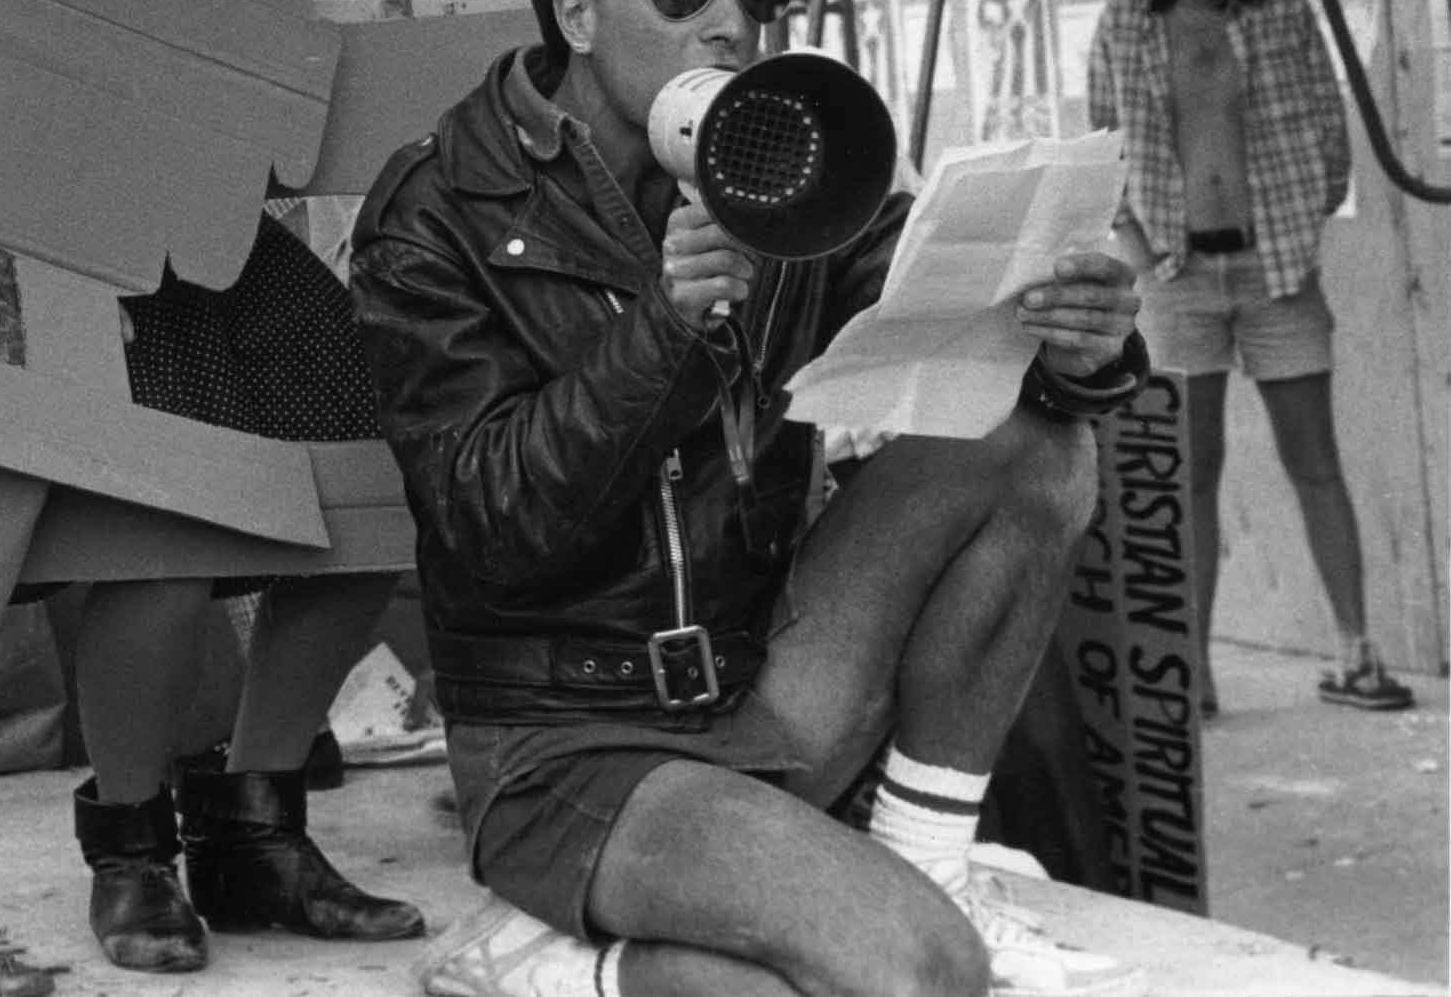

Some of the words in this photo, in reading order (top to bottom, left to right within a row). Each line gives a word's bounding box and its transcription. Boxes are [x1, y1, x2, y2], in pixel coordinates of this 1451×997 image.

[1116, 375, 1190, 637] CHRISTIAN
[1077, 640, 1121, 720] OF
[1128, 645, 1199, 902] SPIRITUAL
